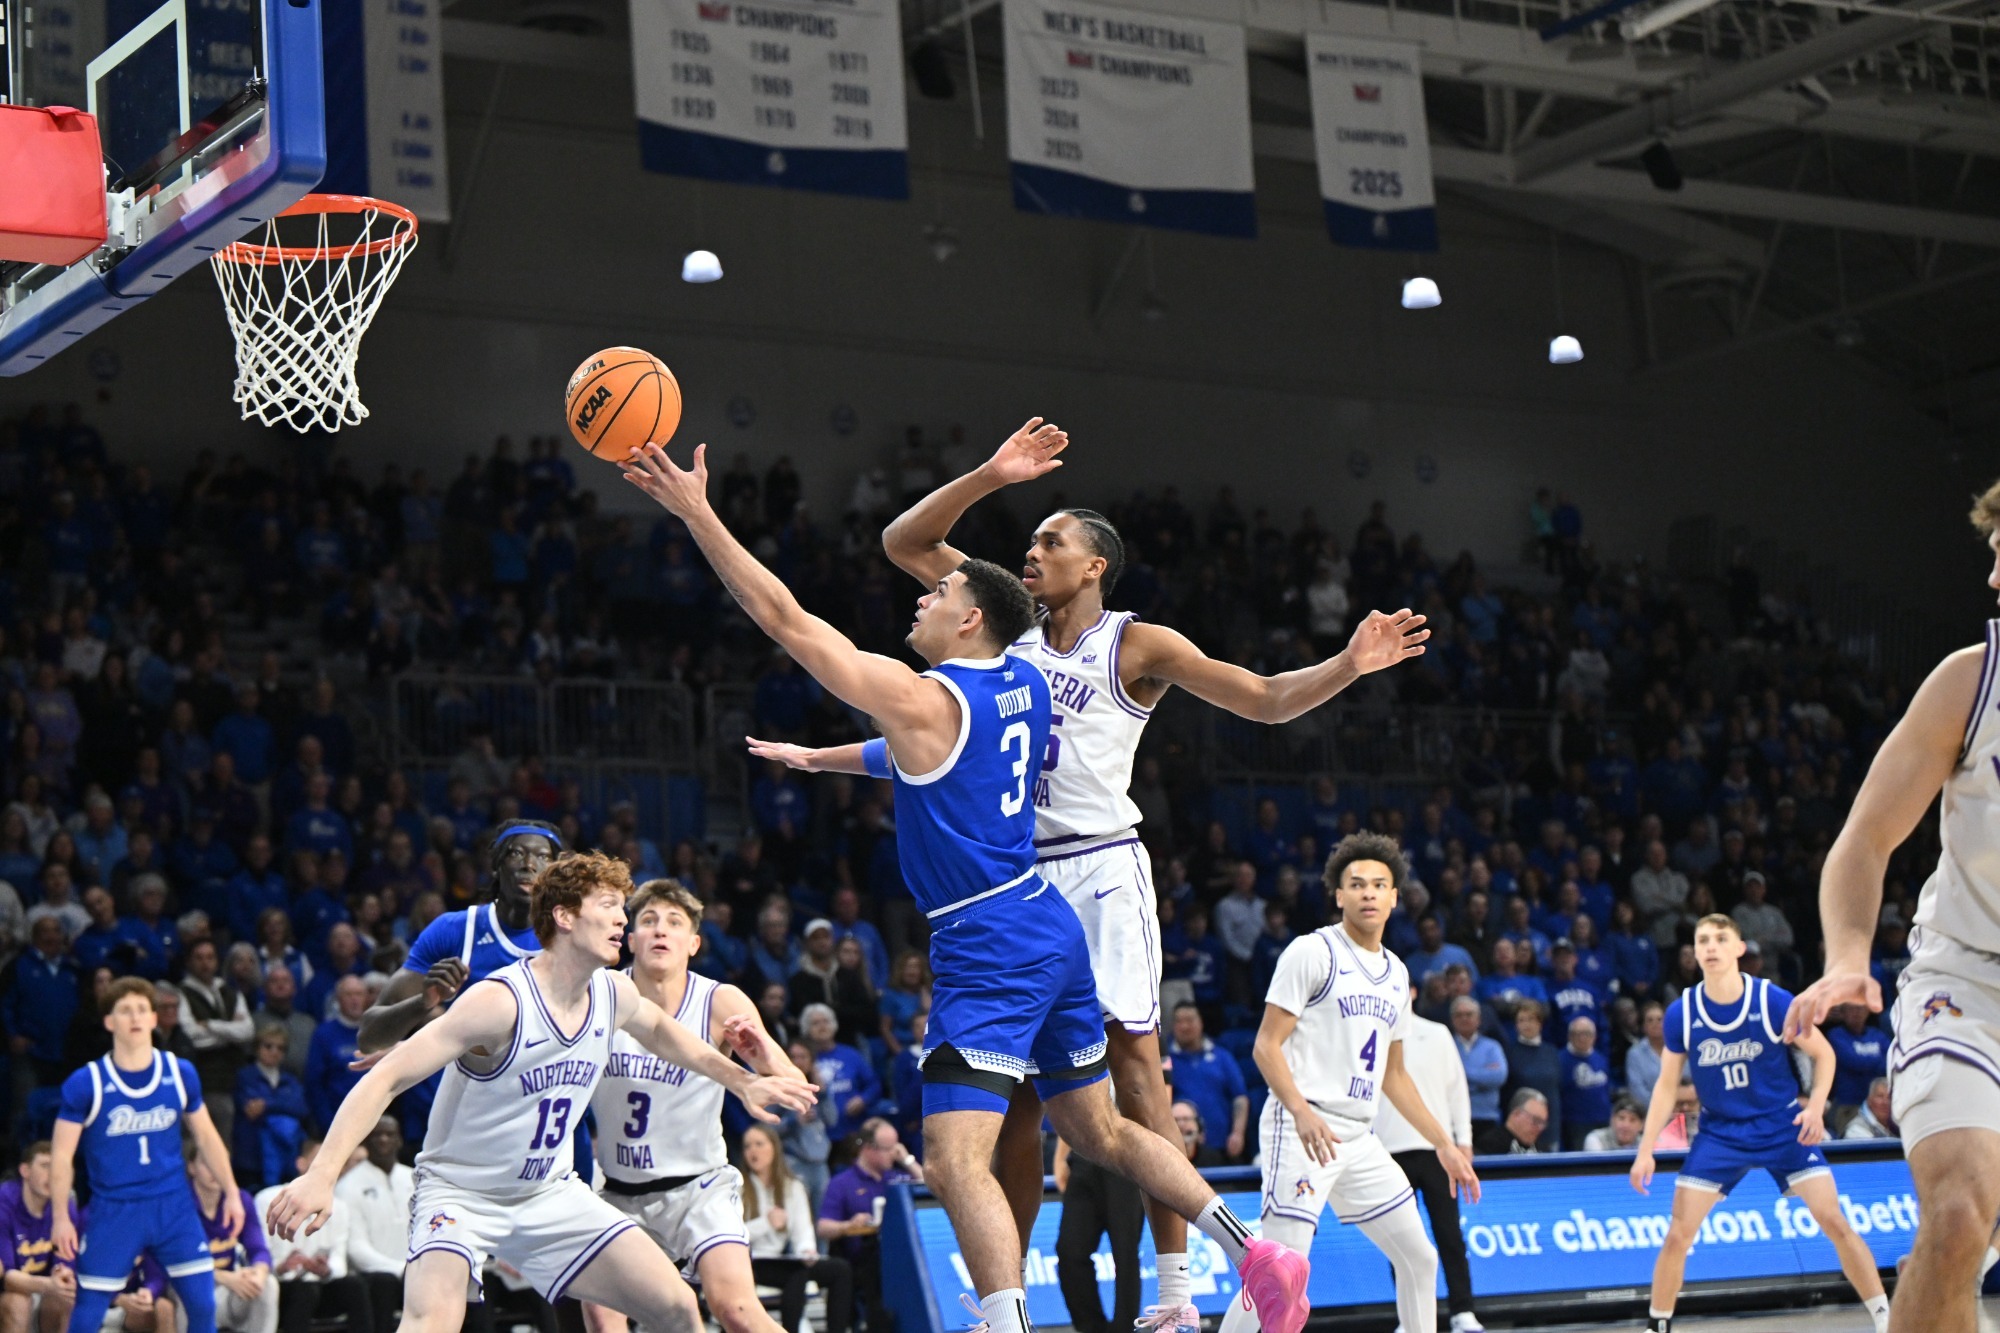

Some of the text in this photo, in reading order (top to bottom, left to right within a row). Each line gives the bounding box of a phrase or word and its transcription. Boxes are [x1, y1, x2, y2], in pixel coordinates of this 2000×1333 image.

[735, 6, 838, 38] CHAMPIONS
[1104, 19, 1206, 54] BASKETBALL
[1098, 54, 1193, 86] CHAMPIONS
[1335, 127, 1408, 148] CHAMPIONS
[1349, 168, 1403, 198] 2025
[576, 385, 613, 435] NCAA
[995, 685, 1032, 718] QUINN
[1000, 721, 1030, 817] 3
[1360, 1029, 1377, 1072] 4
[1697, 1038, 1763, 1067] Drake
[519, 1060, 599, 1097] NORTHERN
[1347, 1076, 1374, 1101] IOWA
[1721, 1063, 1749, 1090] 10
[106, 1104, 177, 1136] Drake
[530, 1097, 572, 1150] 13
[623, 1091, 651, 1139] 3
[138, 1135, 150, 1165] 1
[616, 1143, 654, 1169] IOWA
[1461, 1194, 1919, 1258] our chamion fo bett
